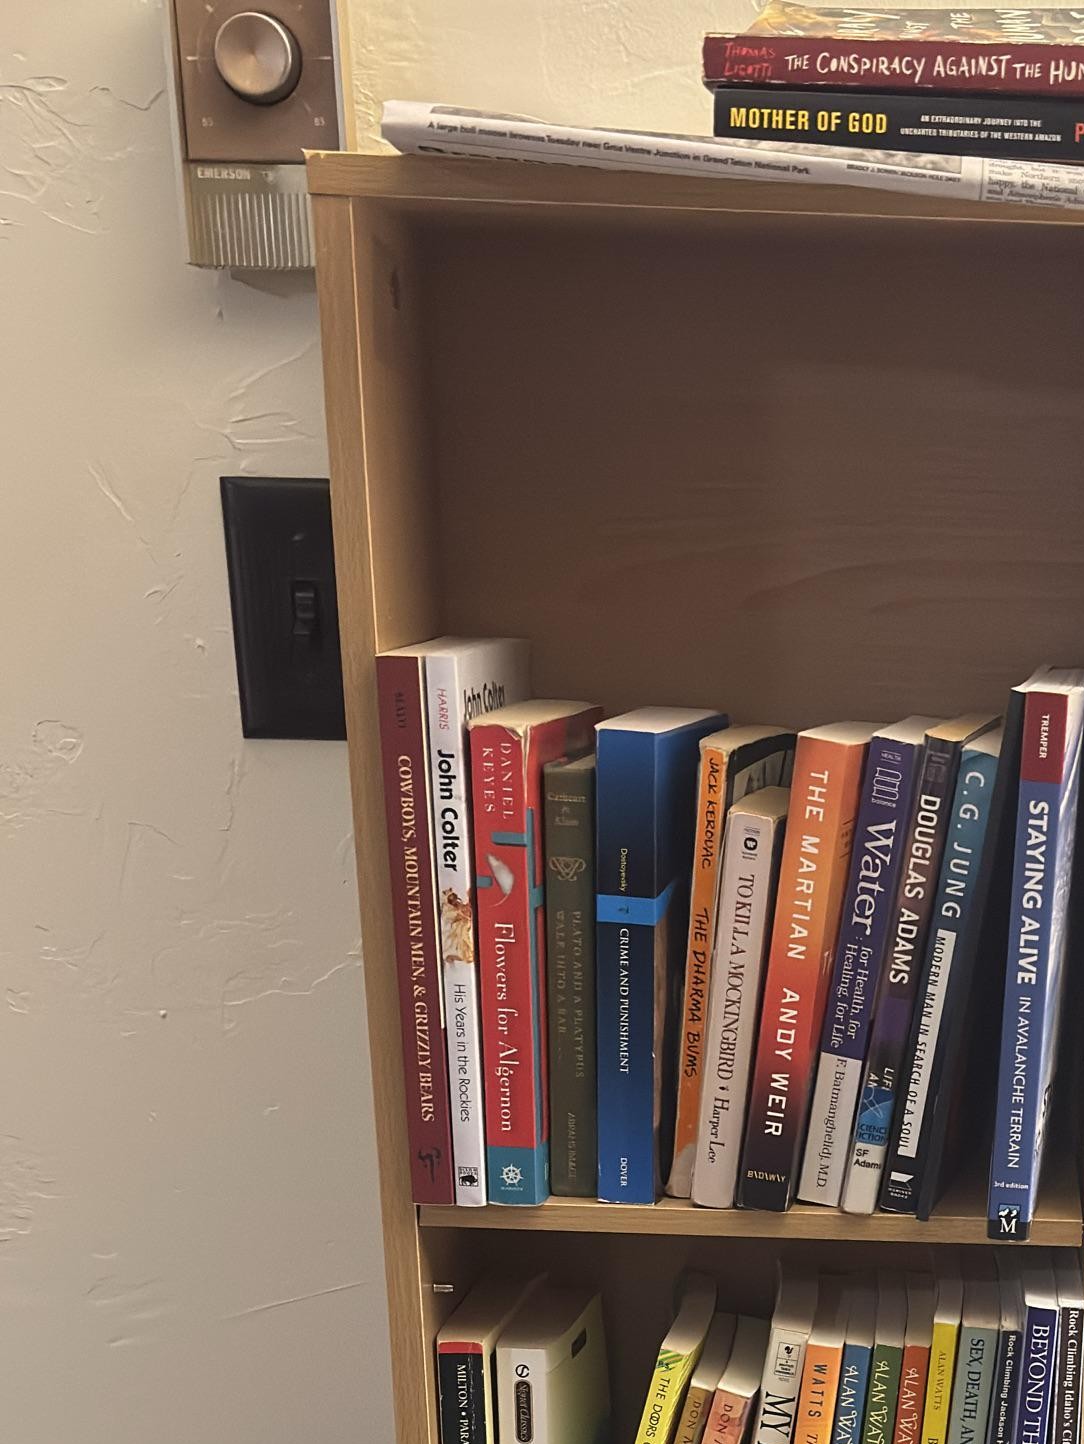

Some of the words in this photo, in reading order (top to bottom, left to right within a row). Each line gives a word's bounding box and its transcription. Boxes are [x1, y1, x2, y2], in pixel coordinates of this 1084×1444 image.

[724, 62, 772, 77] LIGOTTI
[725, 42, 777, 60] THOMAS
[785, 55, 809, 72] THE
[816, 52, 926, 80] CONSPIRACY
[933, 55, 1012, 78] AGAINST
[1013, 63, 1042, 79] THE
[729, 107, 808, 132] MOTHER
[816, 111, 842, 132] OF
[848, 111, 887, 134] GOD
[197, 167, 251, 180] EMERSON
[437, 688, 450, 730] HARRIS
[1039, 714, 1050, 758] TREMPER
[437, 749, 456, 800] John
[805, 770, 828, 822] THE
[398, 755, 416, 841] COWBOYS,
[441, 807, 459, 871] Colter
[904, 795, 940, 898] DOUGLAS
[1022, 801, 1049, 908] STAYING
[404, 847, 422, 937] MOUNTAIN
[619, 848, 628, 891] Dostoyevsky
[852, 821, 896, 935] Water
[788, 835, 820, 959] MARTIAN
[410, 942, 425, 981] MEN,
[494, 923, 515, 1000] Flowers
[619, 928, 629, 966] CRIME
[889, 908, 919, 983] ADAMS
[1017, 916, 1040, 984] ALIVE
[413, 984, 426, 997] &
[453, 983, 466, 1003] His
[619, 968, 629, 996] AND
[1018, 996, 1031, 1012] IN
[414, 1001, 431, 1067] GRIZZLY
[455, 1006, 467, 1038] Years
[497, 1008, 518, 1035] for
[619, 999, 629, 1073] PUNISHMENT
[775, 988, 800, 1060] ANDY
[456, 1041, 466, 1052] in
[457, 1055, 469, 1075] the
[1012, 1016, 1029, 1103] AVALANCHE
[419, 1072, 434, 1121] BEARS
[458, 1078, 471, 1122] Rockies
[495, 1041, 519, 1131] Algernon
[764, 1073, 789, 1135] WEIR
[1007, 1108, 1023, 1168] TERRAIN
[620, 1157, 628, 1186] DOVER
[1068, 1310, 1079, 1336] Rock
[1025, 1325, 1050, 1412] BEYOND
[1063, 1339, 1078, 1387] Climbing
[655, 1378, 671, 1400] THE
[808, 1364, 827, 1417] WATTS
[1063, 1390, 1075, 1427] Idaho's
[645, 1403, 663, 1437] DOORS
[757, 1391, 796, 1437] MY
